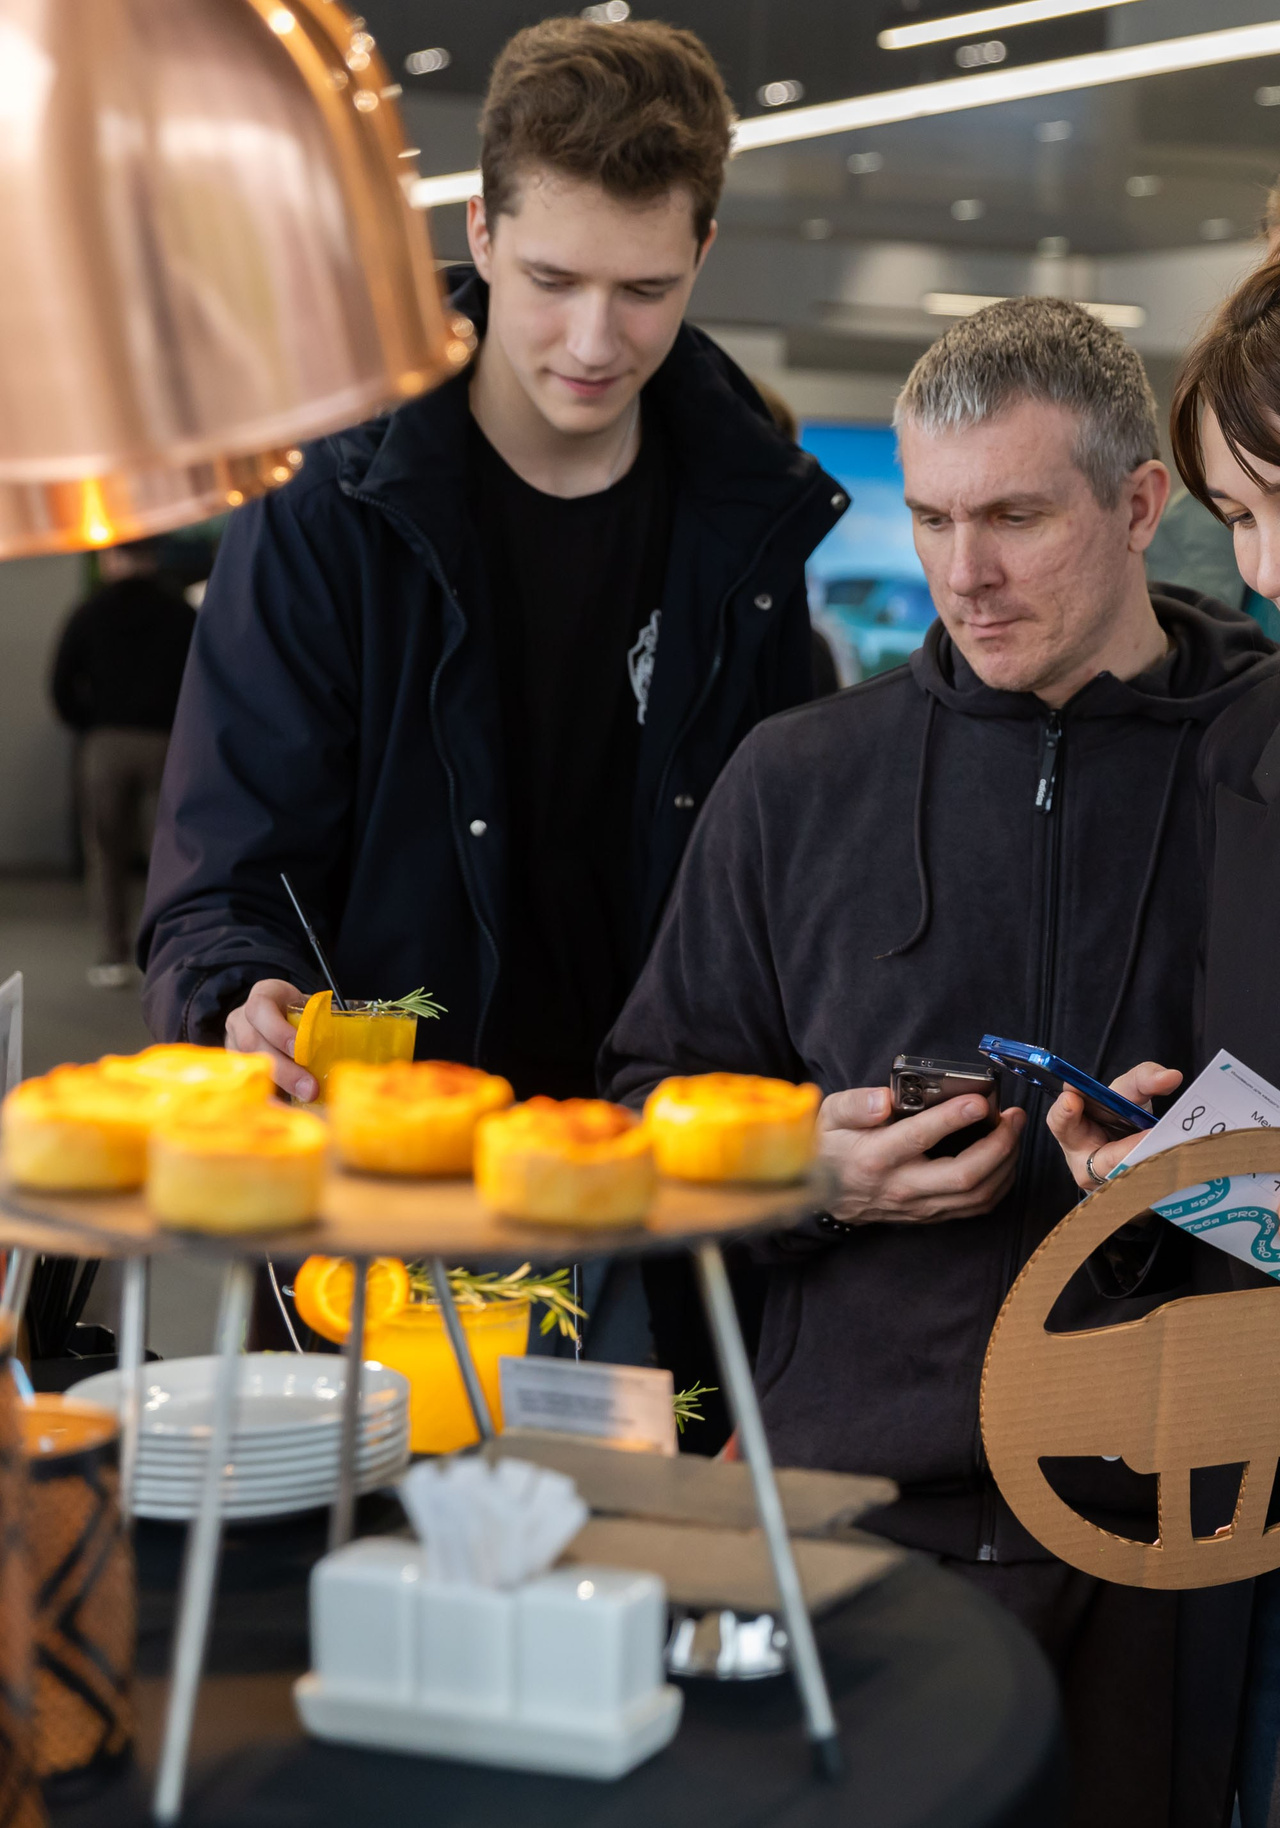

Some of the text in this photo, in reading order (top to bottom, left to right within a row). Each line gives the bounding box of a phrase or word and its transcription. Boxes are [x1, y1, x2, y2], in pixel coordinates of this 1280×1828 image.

[1181, 1105, 1206, 1132] 8
[1190, 1188, 1224, 1208] Тебя
[1227, 1210, 1259, 1220] PRO
[1262, 1212, 1276, 1236] Тебя
[1185, 1218, 1220, 1232] Тебя
[1256, 1240, 1272, 1259] PRO
